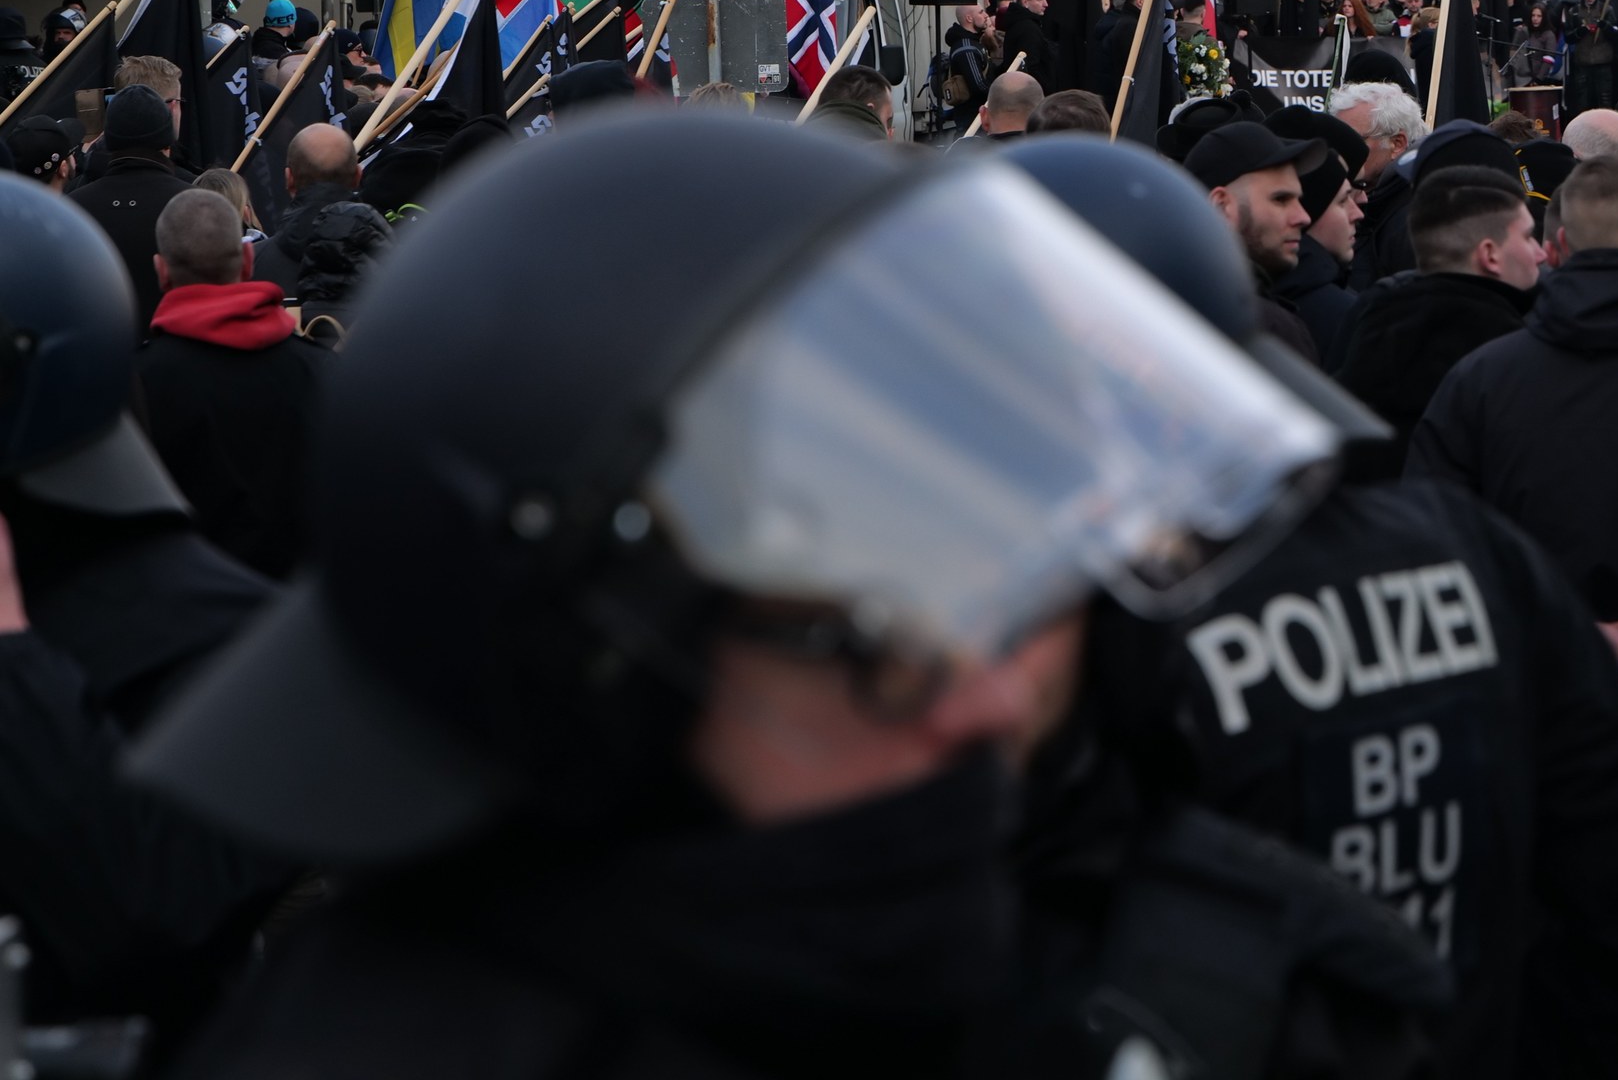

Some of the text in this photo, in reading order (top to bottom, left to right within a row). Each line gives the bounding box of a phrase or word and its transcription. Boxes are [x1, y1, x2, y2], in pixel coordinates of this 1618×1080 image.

[1252, 69, 1279, 88] DIE
[1185, 560, 1499, 735] POLIZEI
[1351, 723, 1442, 819] BP
[1330, 801, 1463, 896] BLU
